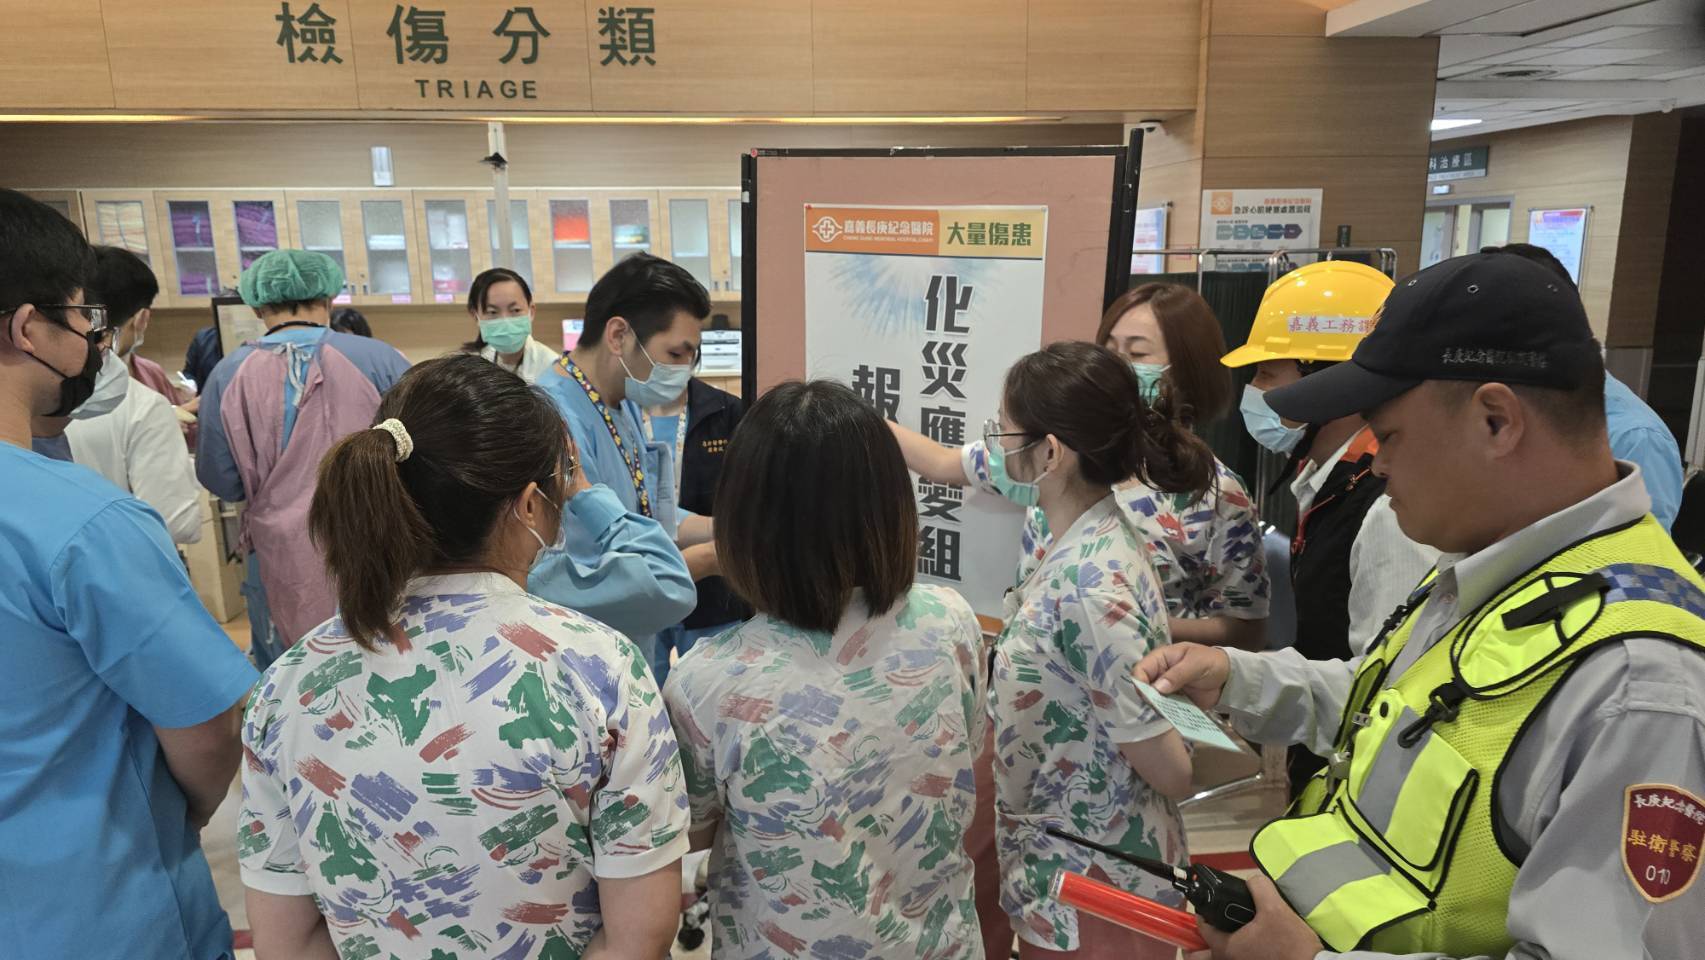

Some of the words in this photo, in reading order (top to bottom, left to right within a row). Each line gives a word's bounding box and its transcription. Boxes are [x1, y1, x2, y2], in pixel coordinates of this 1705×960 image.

[275, 2, 657, 66] 檢傷分類
[415, 79, 538, 99] TRIAGE
[843, 219, 934, 236] 嘉義長庚紀念醫院
[947, 221, 1032, 246] 大量傷患
[1634, 794, 1705, 825] 長庚紀念醫院
[1628, 829, 1697, 862] 駐衛警察
[1645, 865, 1671, 885] 010
